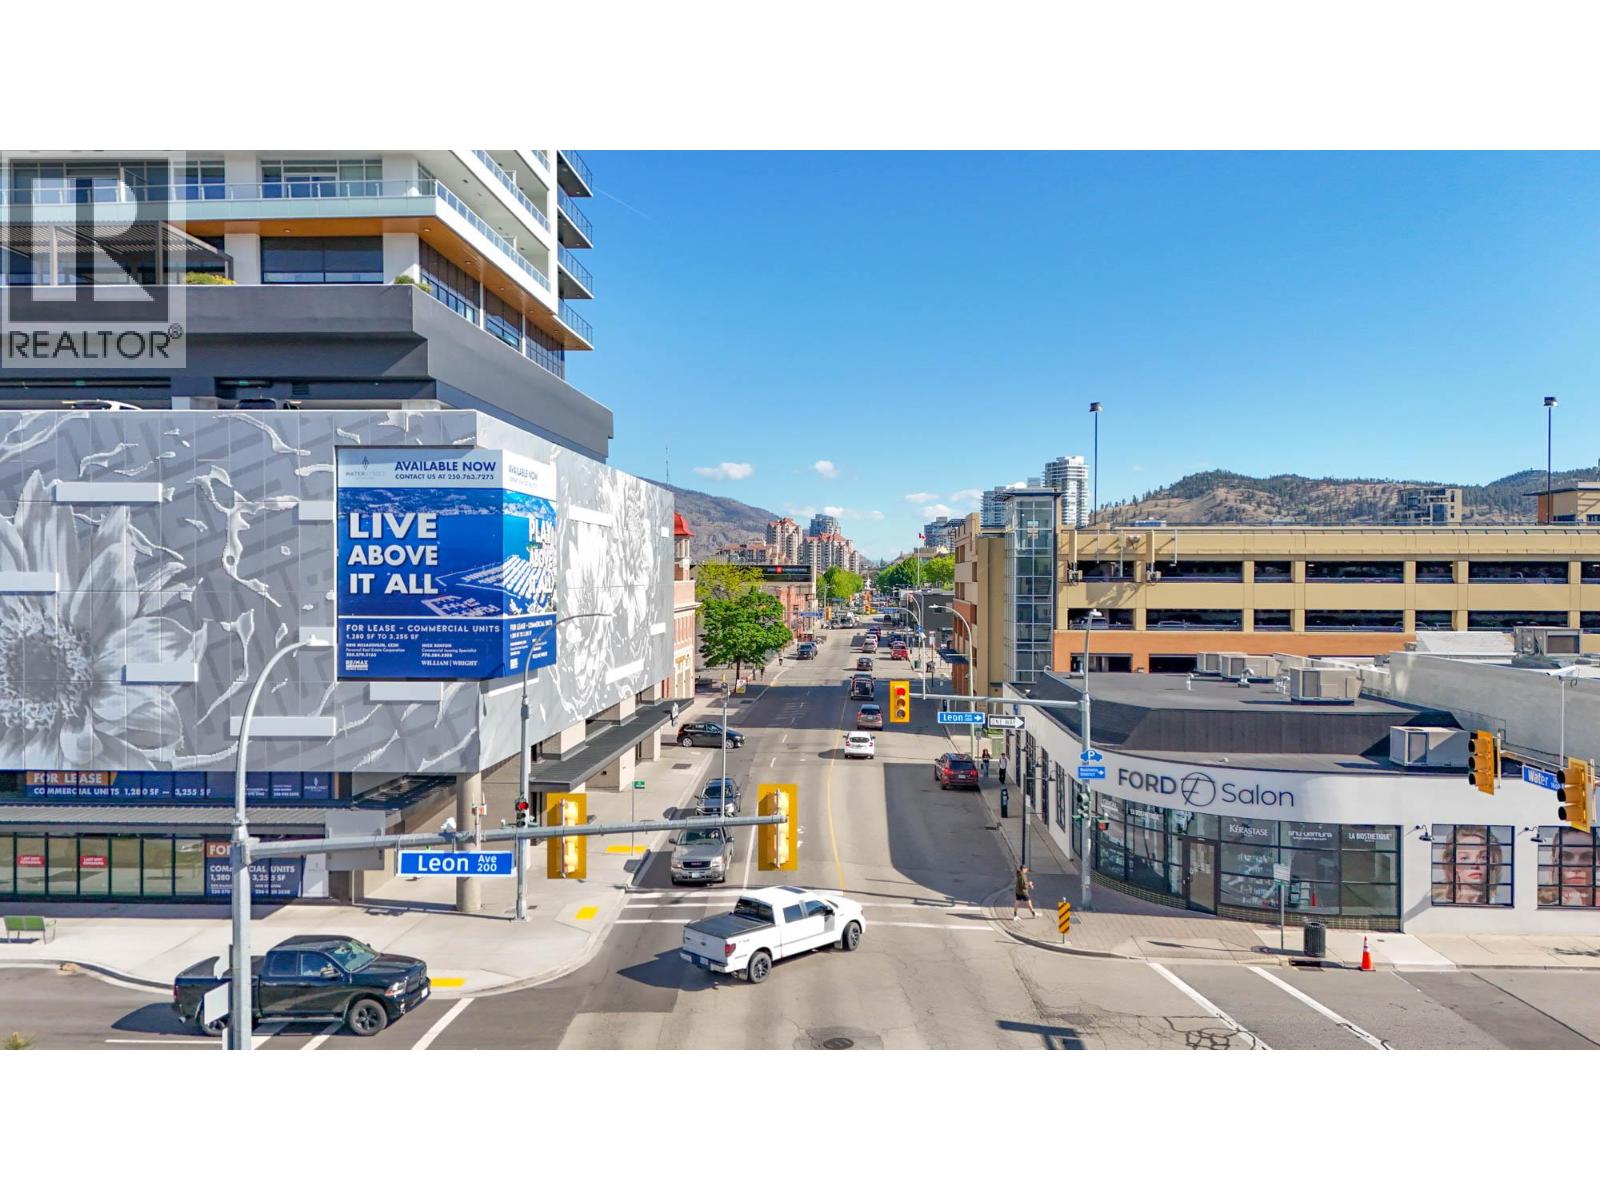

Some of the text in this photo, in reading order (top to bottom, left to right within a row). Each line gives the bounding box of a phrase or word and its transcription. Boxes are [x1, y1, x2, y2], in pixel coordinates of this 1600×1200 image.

[394, 461, 497, 472] AVAILABLE NOW
[348, 512, 438, 540] LIVE
[347, 545, 438, 566] ABOVE
[349, 573, 439, 594] IT ALL
[346, 624, 364, 632] FOR
[367, 624, 396, 632] LEASE
[472, 625, 501, 633] UNITS
[943, 713, 964, 722] Leon
[1088, 750, 1096, 760] P
[33, 773, 102, 783] FOR LEASE
[1527, 769, 1549, 787] Water
[33, 787, 92, 795] COMMERCIAL
[93, 788, 120, 796] UNITS
[150, 788, 159, 796] SF
[1118, 768, 1295, 807] FORD Salon
[418, 854, 497, 872] Leon Ave
[477, 863, 497, 872] 200
[270, 865, 295, 873] UNITS
